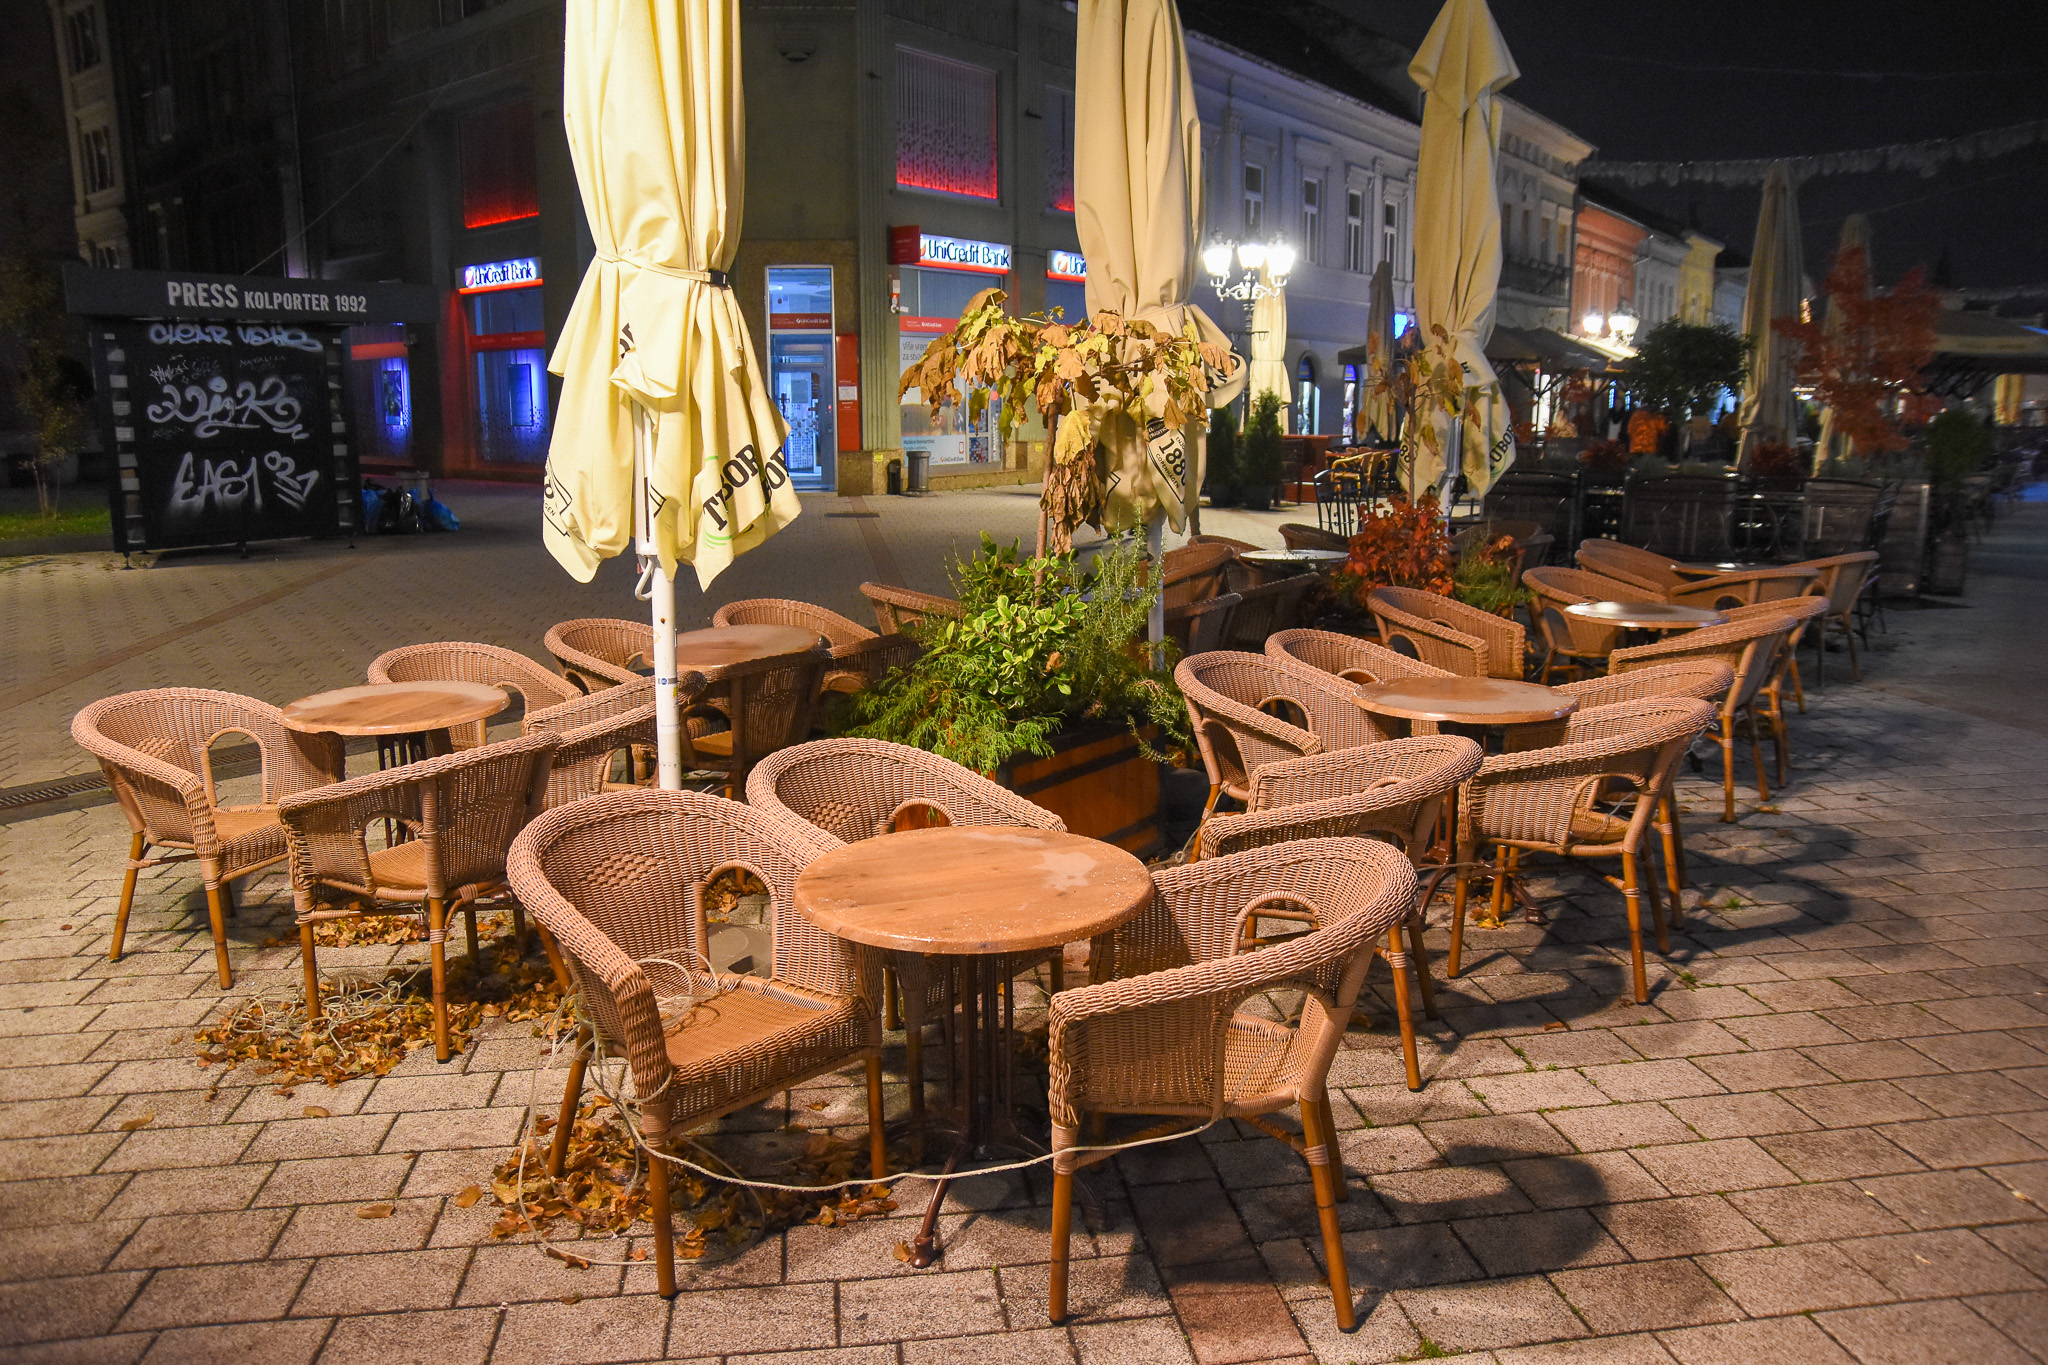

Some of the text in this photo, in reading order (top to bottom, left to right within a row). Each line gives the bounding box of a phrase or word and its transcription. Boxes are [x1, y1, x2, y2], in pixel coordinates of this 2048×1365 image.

[928, 239, 980, 264] UniCredit
[982, 246, 1010, 267] Bank
[475, 261, 533, 285] UniCredit Bank
[166, 281, 367, 313] PRESS KOLPORTER 1992
[1155, 453, 1180, 489] COPENHAGEN
